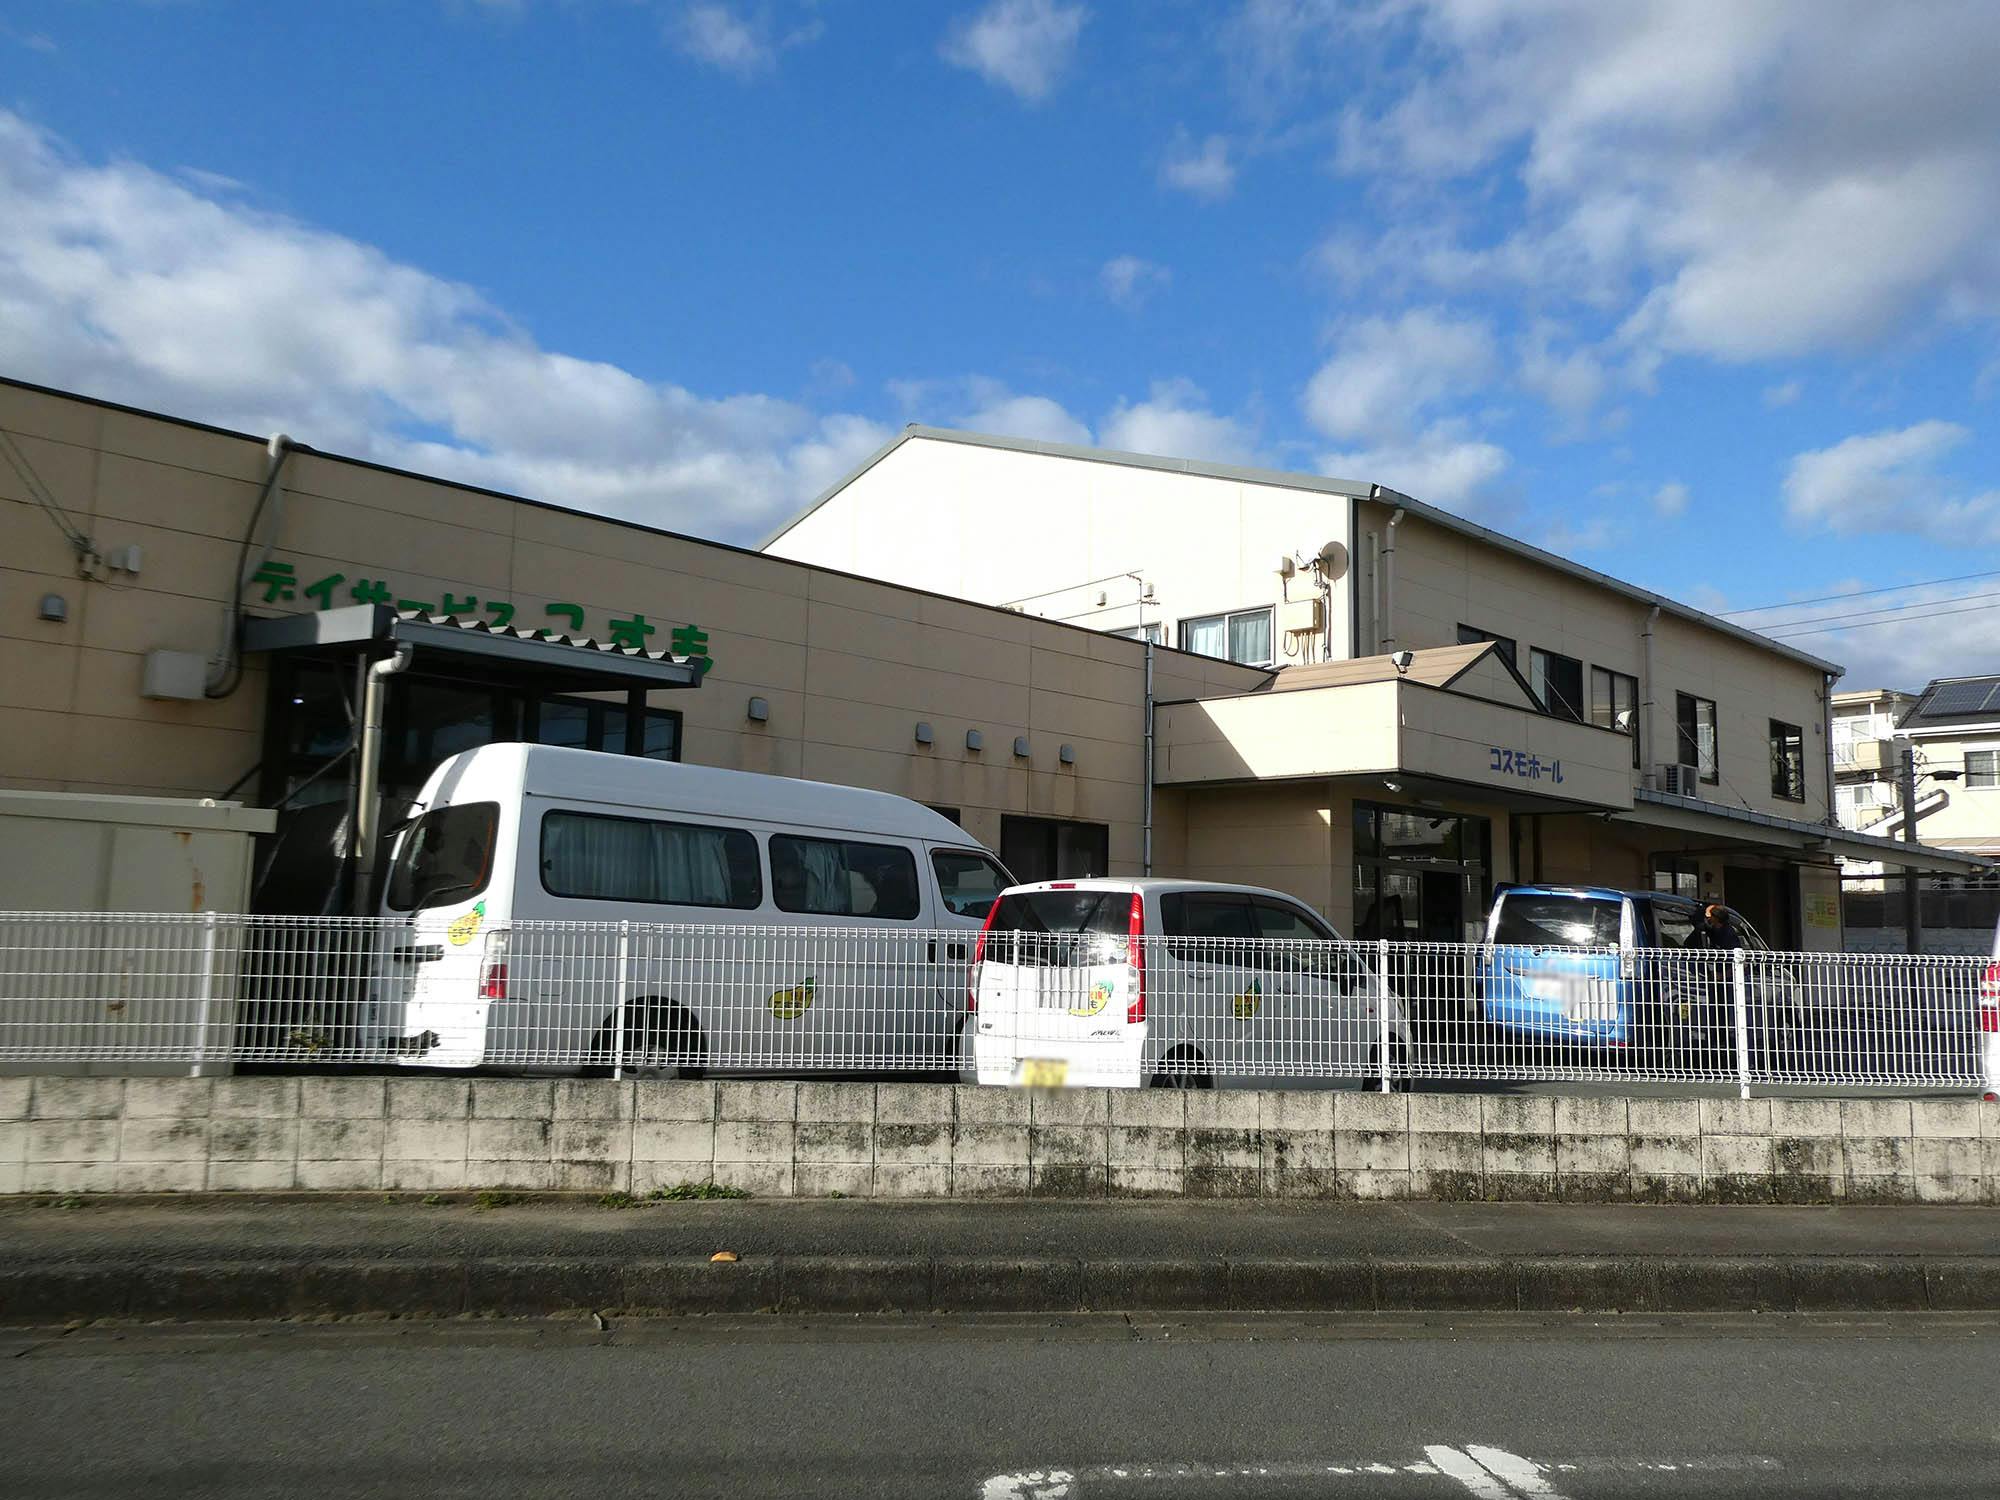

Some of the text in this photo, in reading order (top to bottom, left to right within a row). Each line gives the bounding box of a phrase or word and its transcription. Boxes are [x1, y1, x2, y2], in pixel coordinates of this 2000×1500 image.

[1490, 748, 1563, 784] コスモホール
